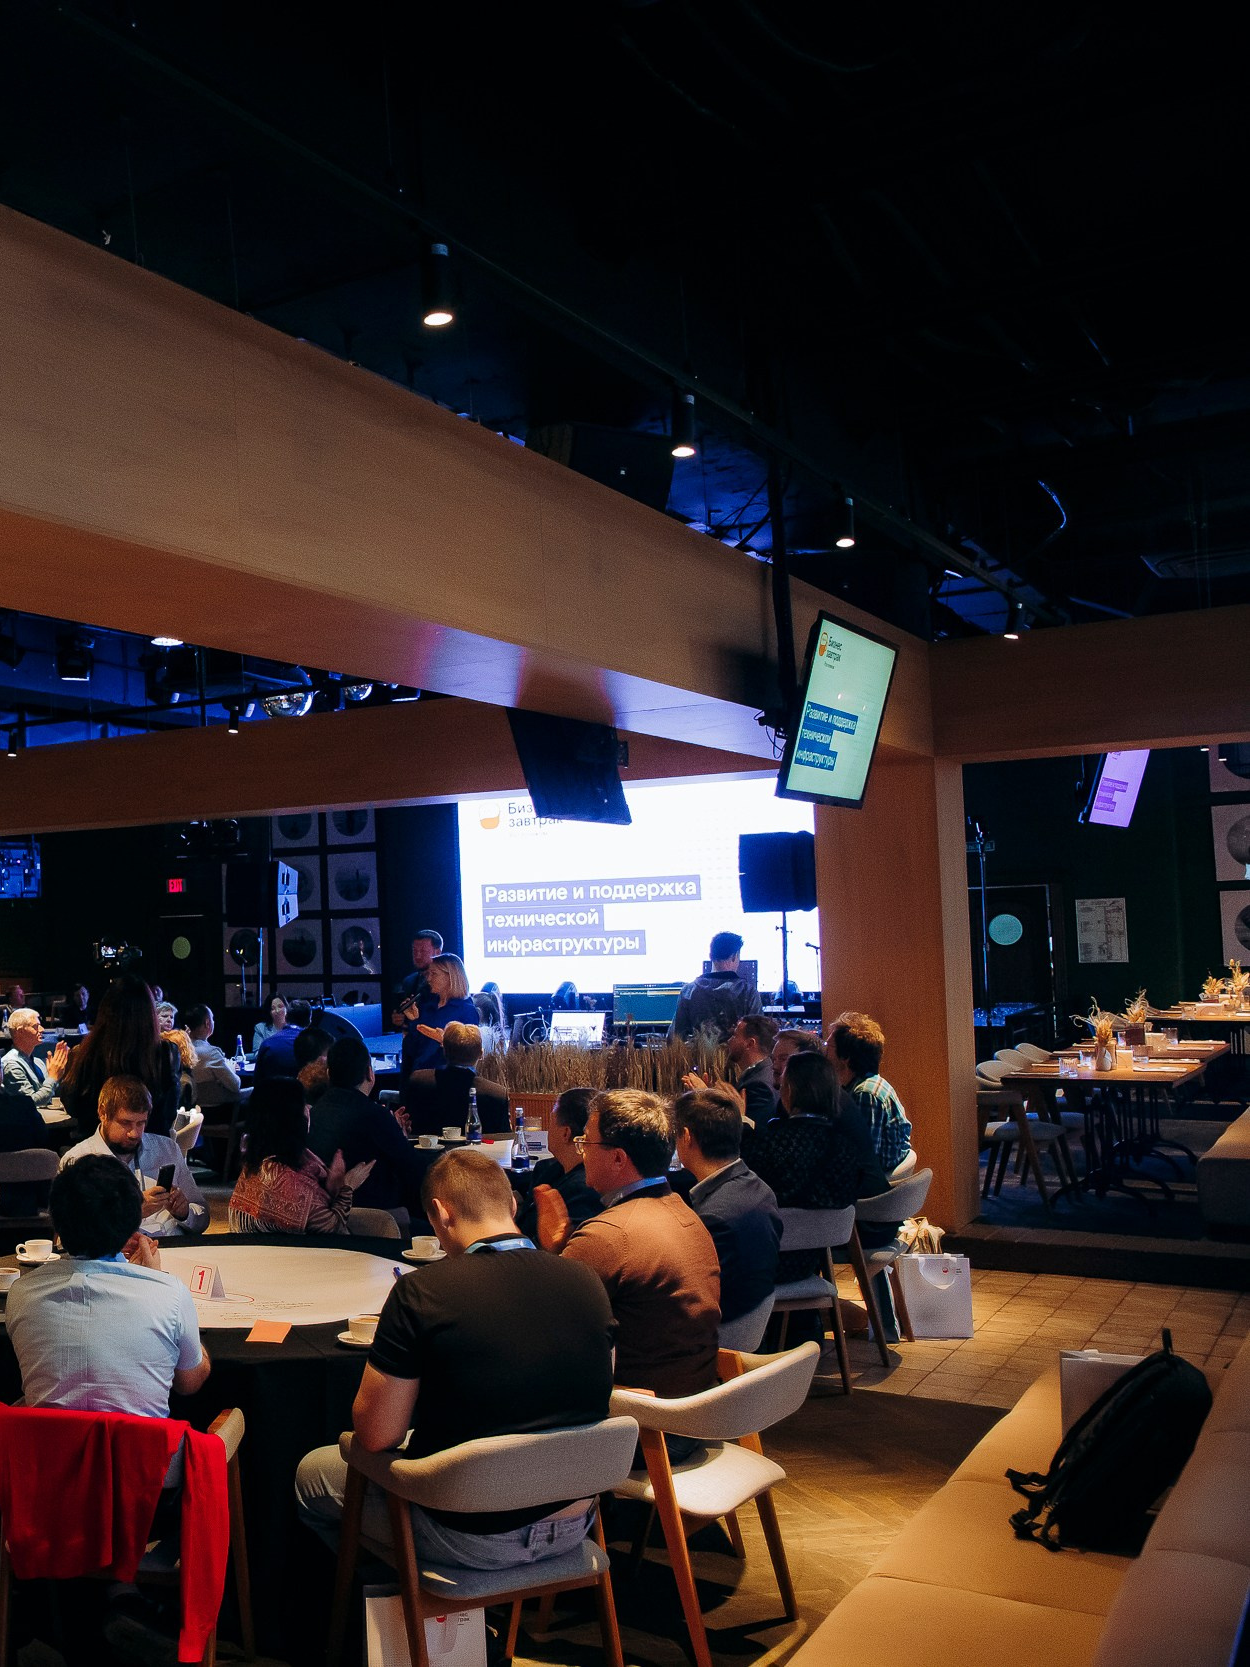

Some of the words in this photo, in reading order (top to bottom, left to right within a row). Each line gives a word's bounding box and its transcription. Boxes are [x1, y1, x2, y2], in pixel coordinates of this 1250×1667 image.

[508, 802, 533, 815] Биз
[485, 886, 568, 903] Развитие
[572, 886, 584, 900] и
[589, 881, 697, 901] поддержка
[486, 908, 599, 928] технической
[487, 935, 640, 956] инфраструктуры
[198, 1270, 205, 1290] 1
